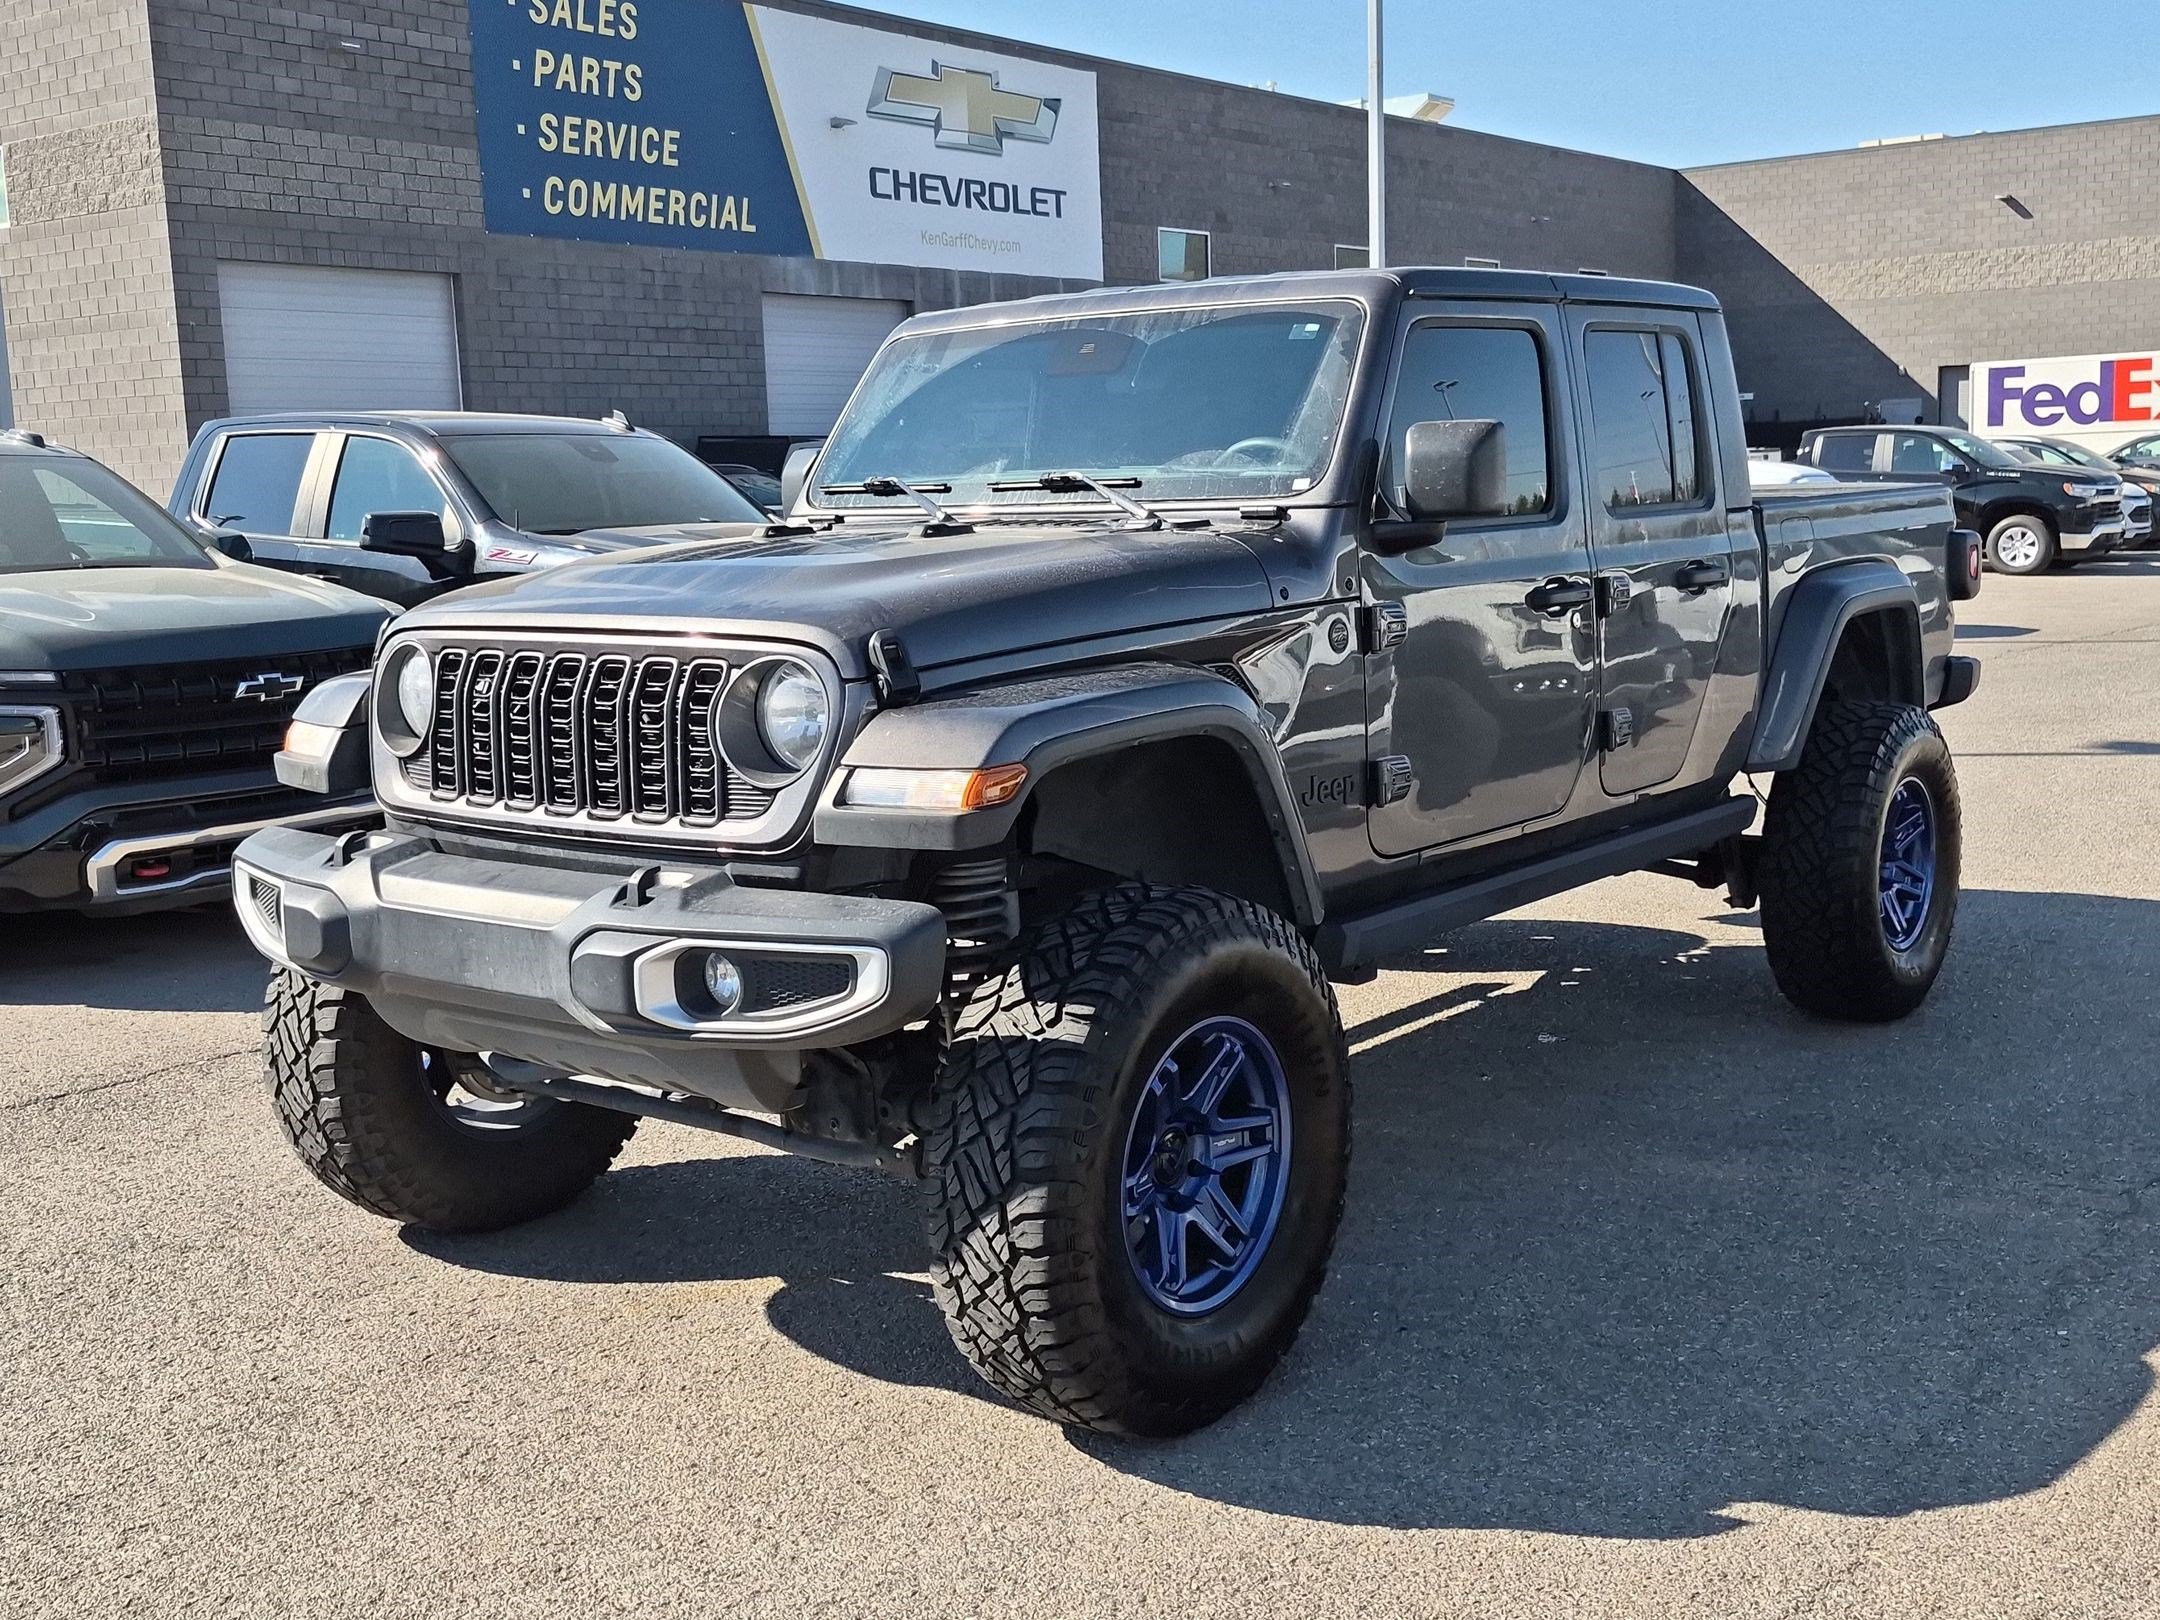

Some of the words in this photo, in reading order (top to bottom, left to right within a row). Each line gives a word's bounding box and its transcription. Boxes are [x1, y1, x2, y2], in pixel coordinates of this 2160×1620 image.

[529, 0, 638, 40] SALES
[534, 49, 643, 102] PARTS
[538, 113, 681, 167] SERVICE
[544, 176, 757, 233] COMMERCIAL
[869, 166, 1067, 219] CHEVROLET
[920, 229, 1022, 255] KenGarffChevy.com
[1987, 358, 2160, 427] FedE
[1301, 774, 1354, 807] Jeep
